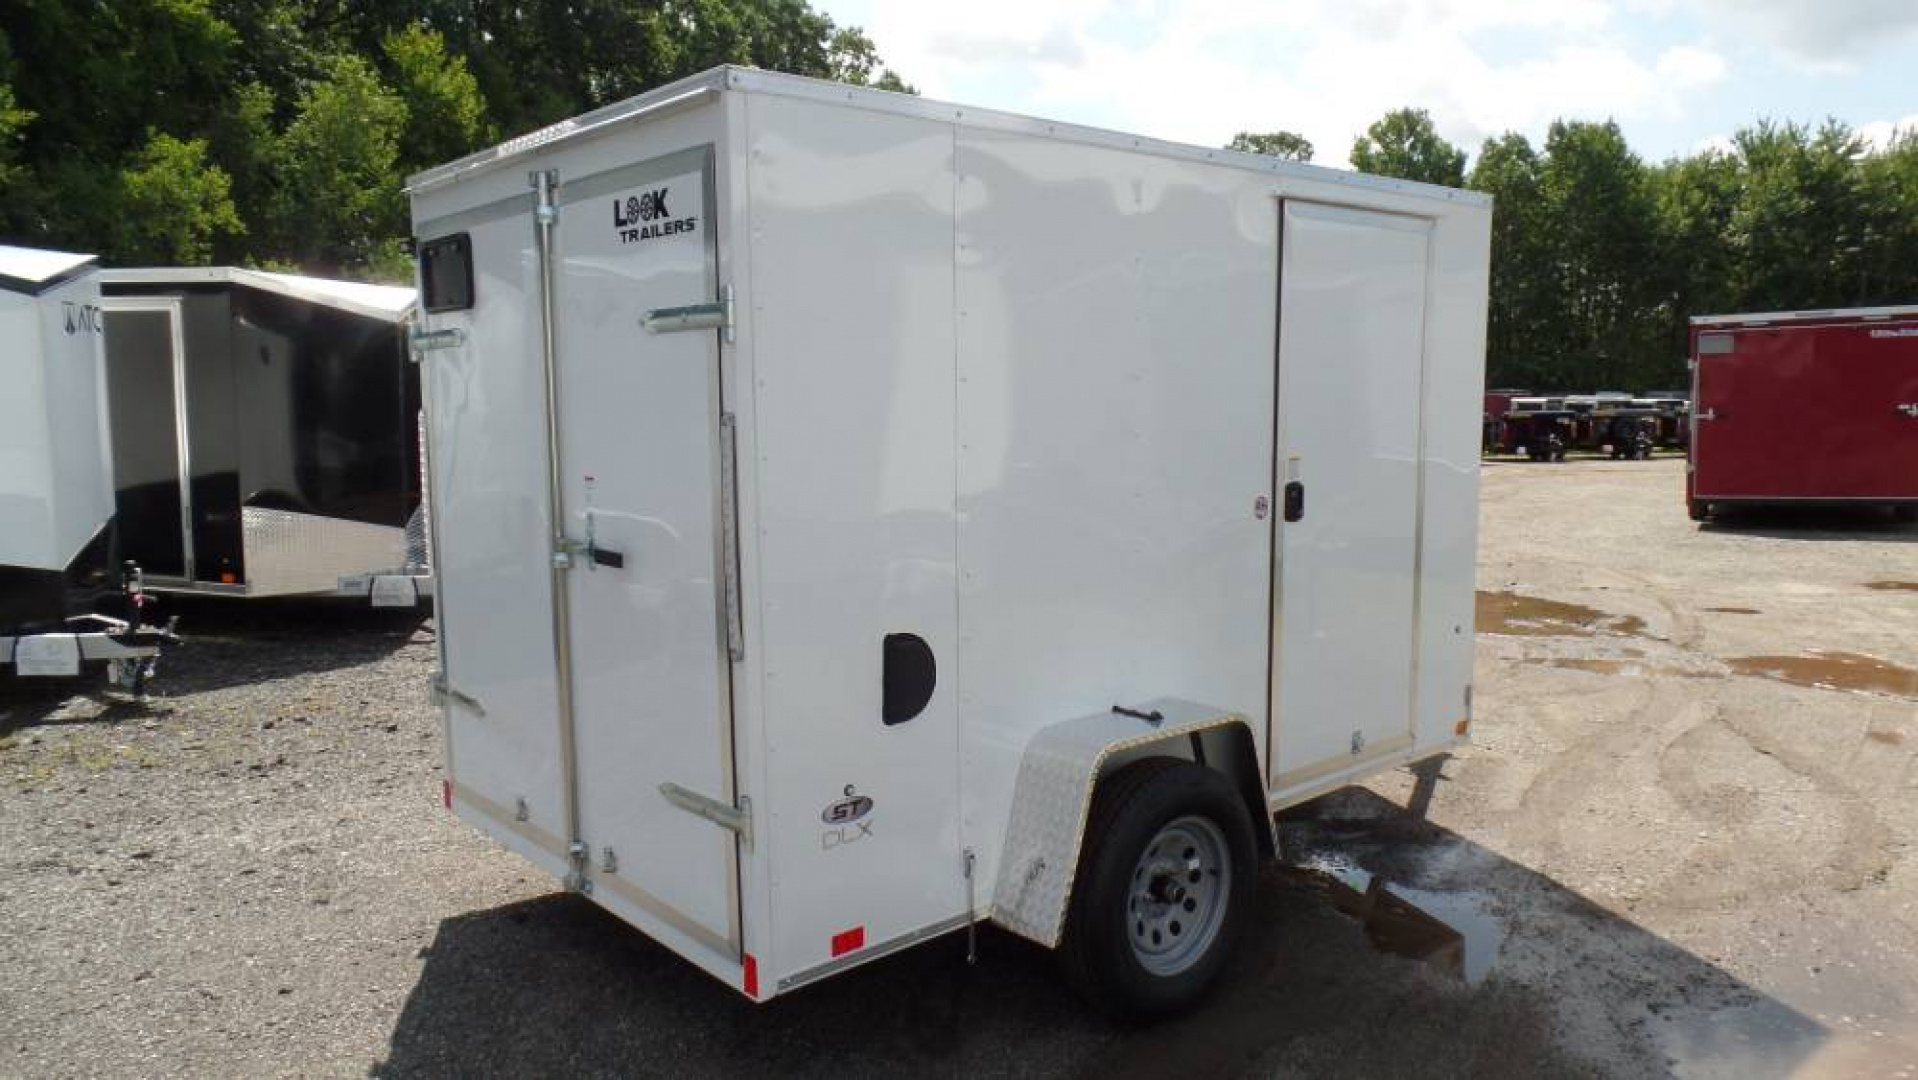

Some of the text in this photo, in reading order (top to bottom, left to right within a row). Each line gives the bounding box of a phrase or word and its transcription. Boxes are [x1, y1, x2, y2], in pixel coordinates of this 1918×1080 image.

[614, 187, 670, 227] LOOK
[619, 216, 696, 244] TRAILERS
[830, 800, 863, 820] ST
[822, 819, 874, 851] DLX
